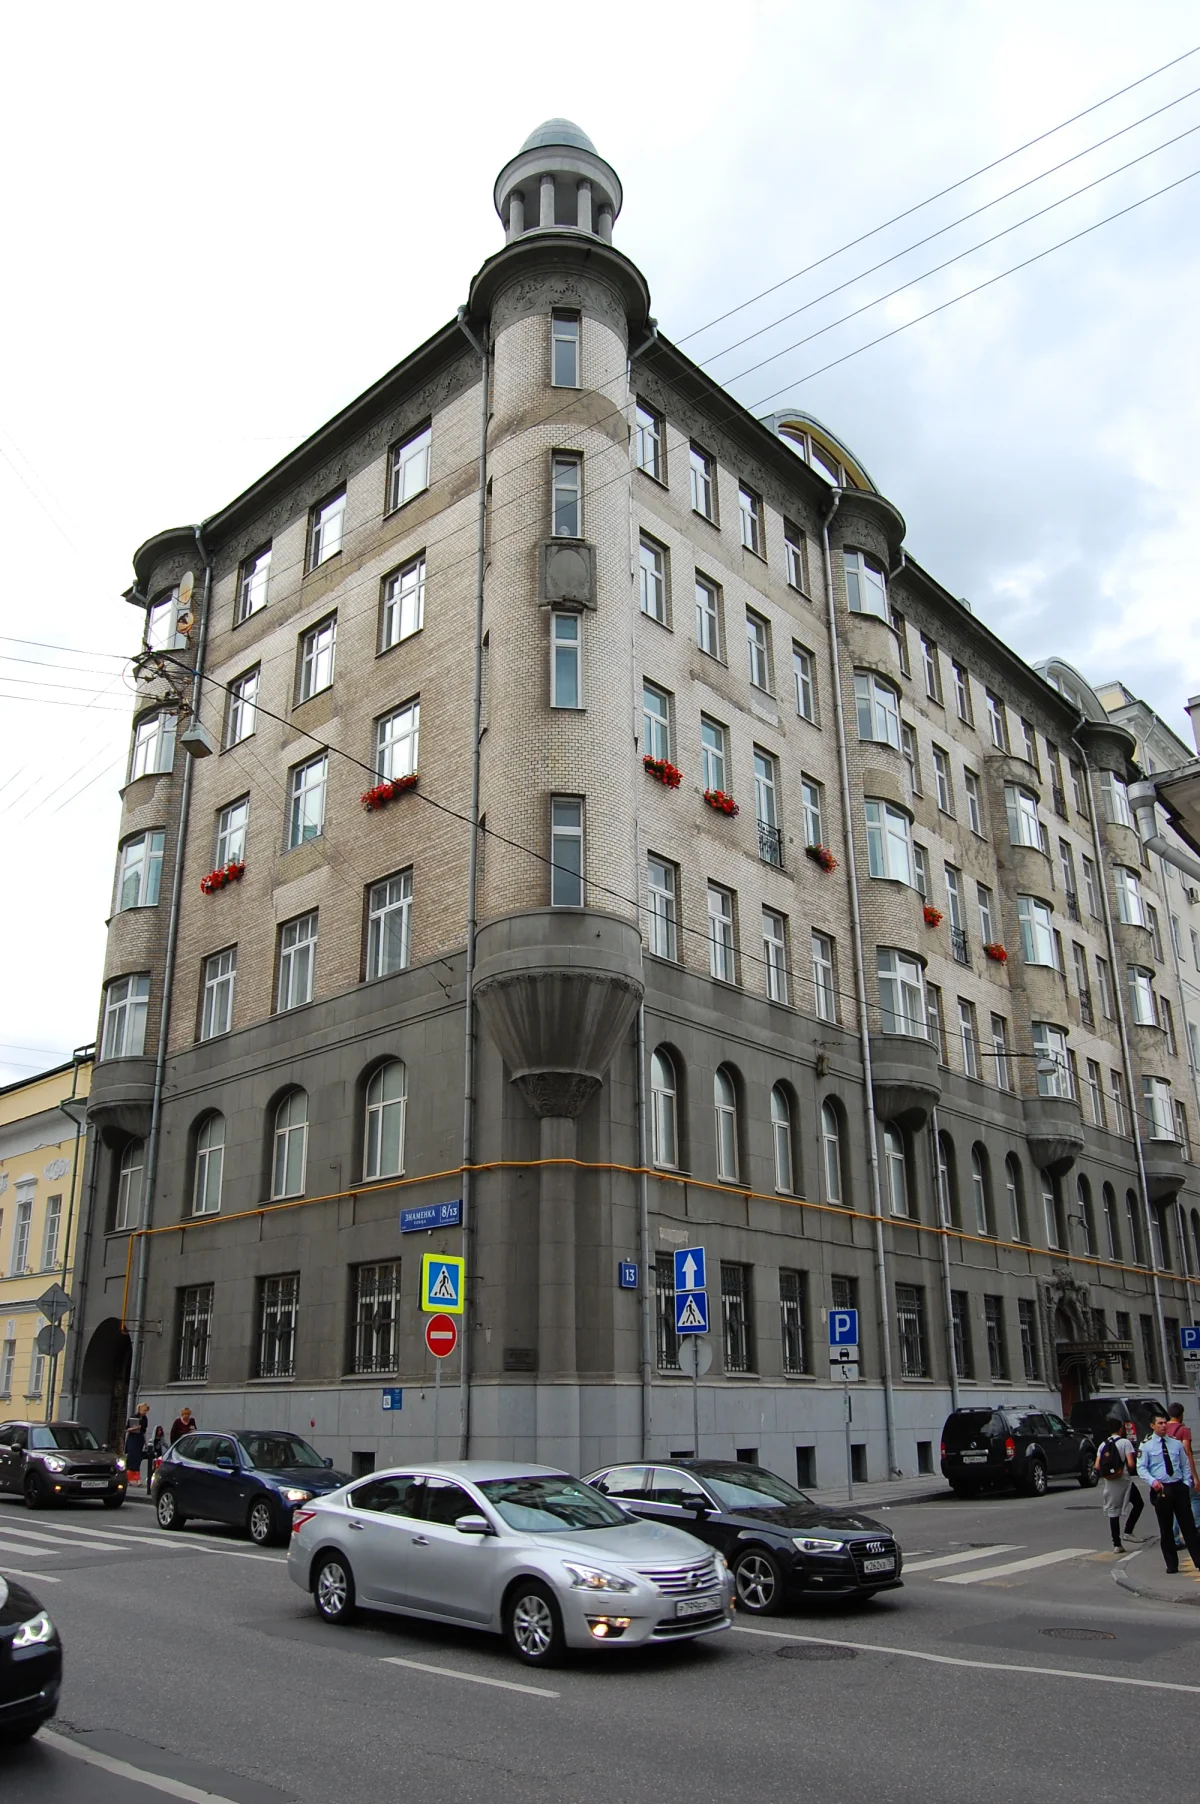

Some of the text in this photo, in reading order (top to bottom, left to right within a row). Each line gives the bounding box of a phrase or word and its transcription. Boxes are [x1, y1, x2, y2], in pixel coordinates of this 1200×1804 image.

[405, 1210, 435, 1221] ЗНАМЕНКА
[441, 1205, 457, 1218] 8/13
[625, 1269, 635, 1281] 13
[835, 1314, 850, 1341] P
[1185, 1330, 1196, 1347] P
